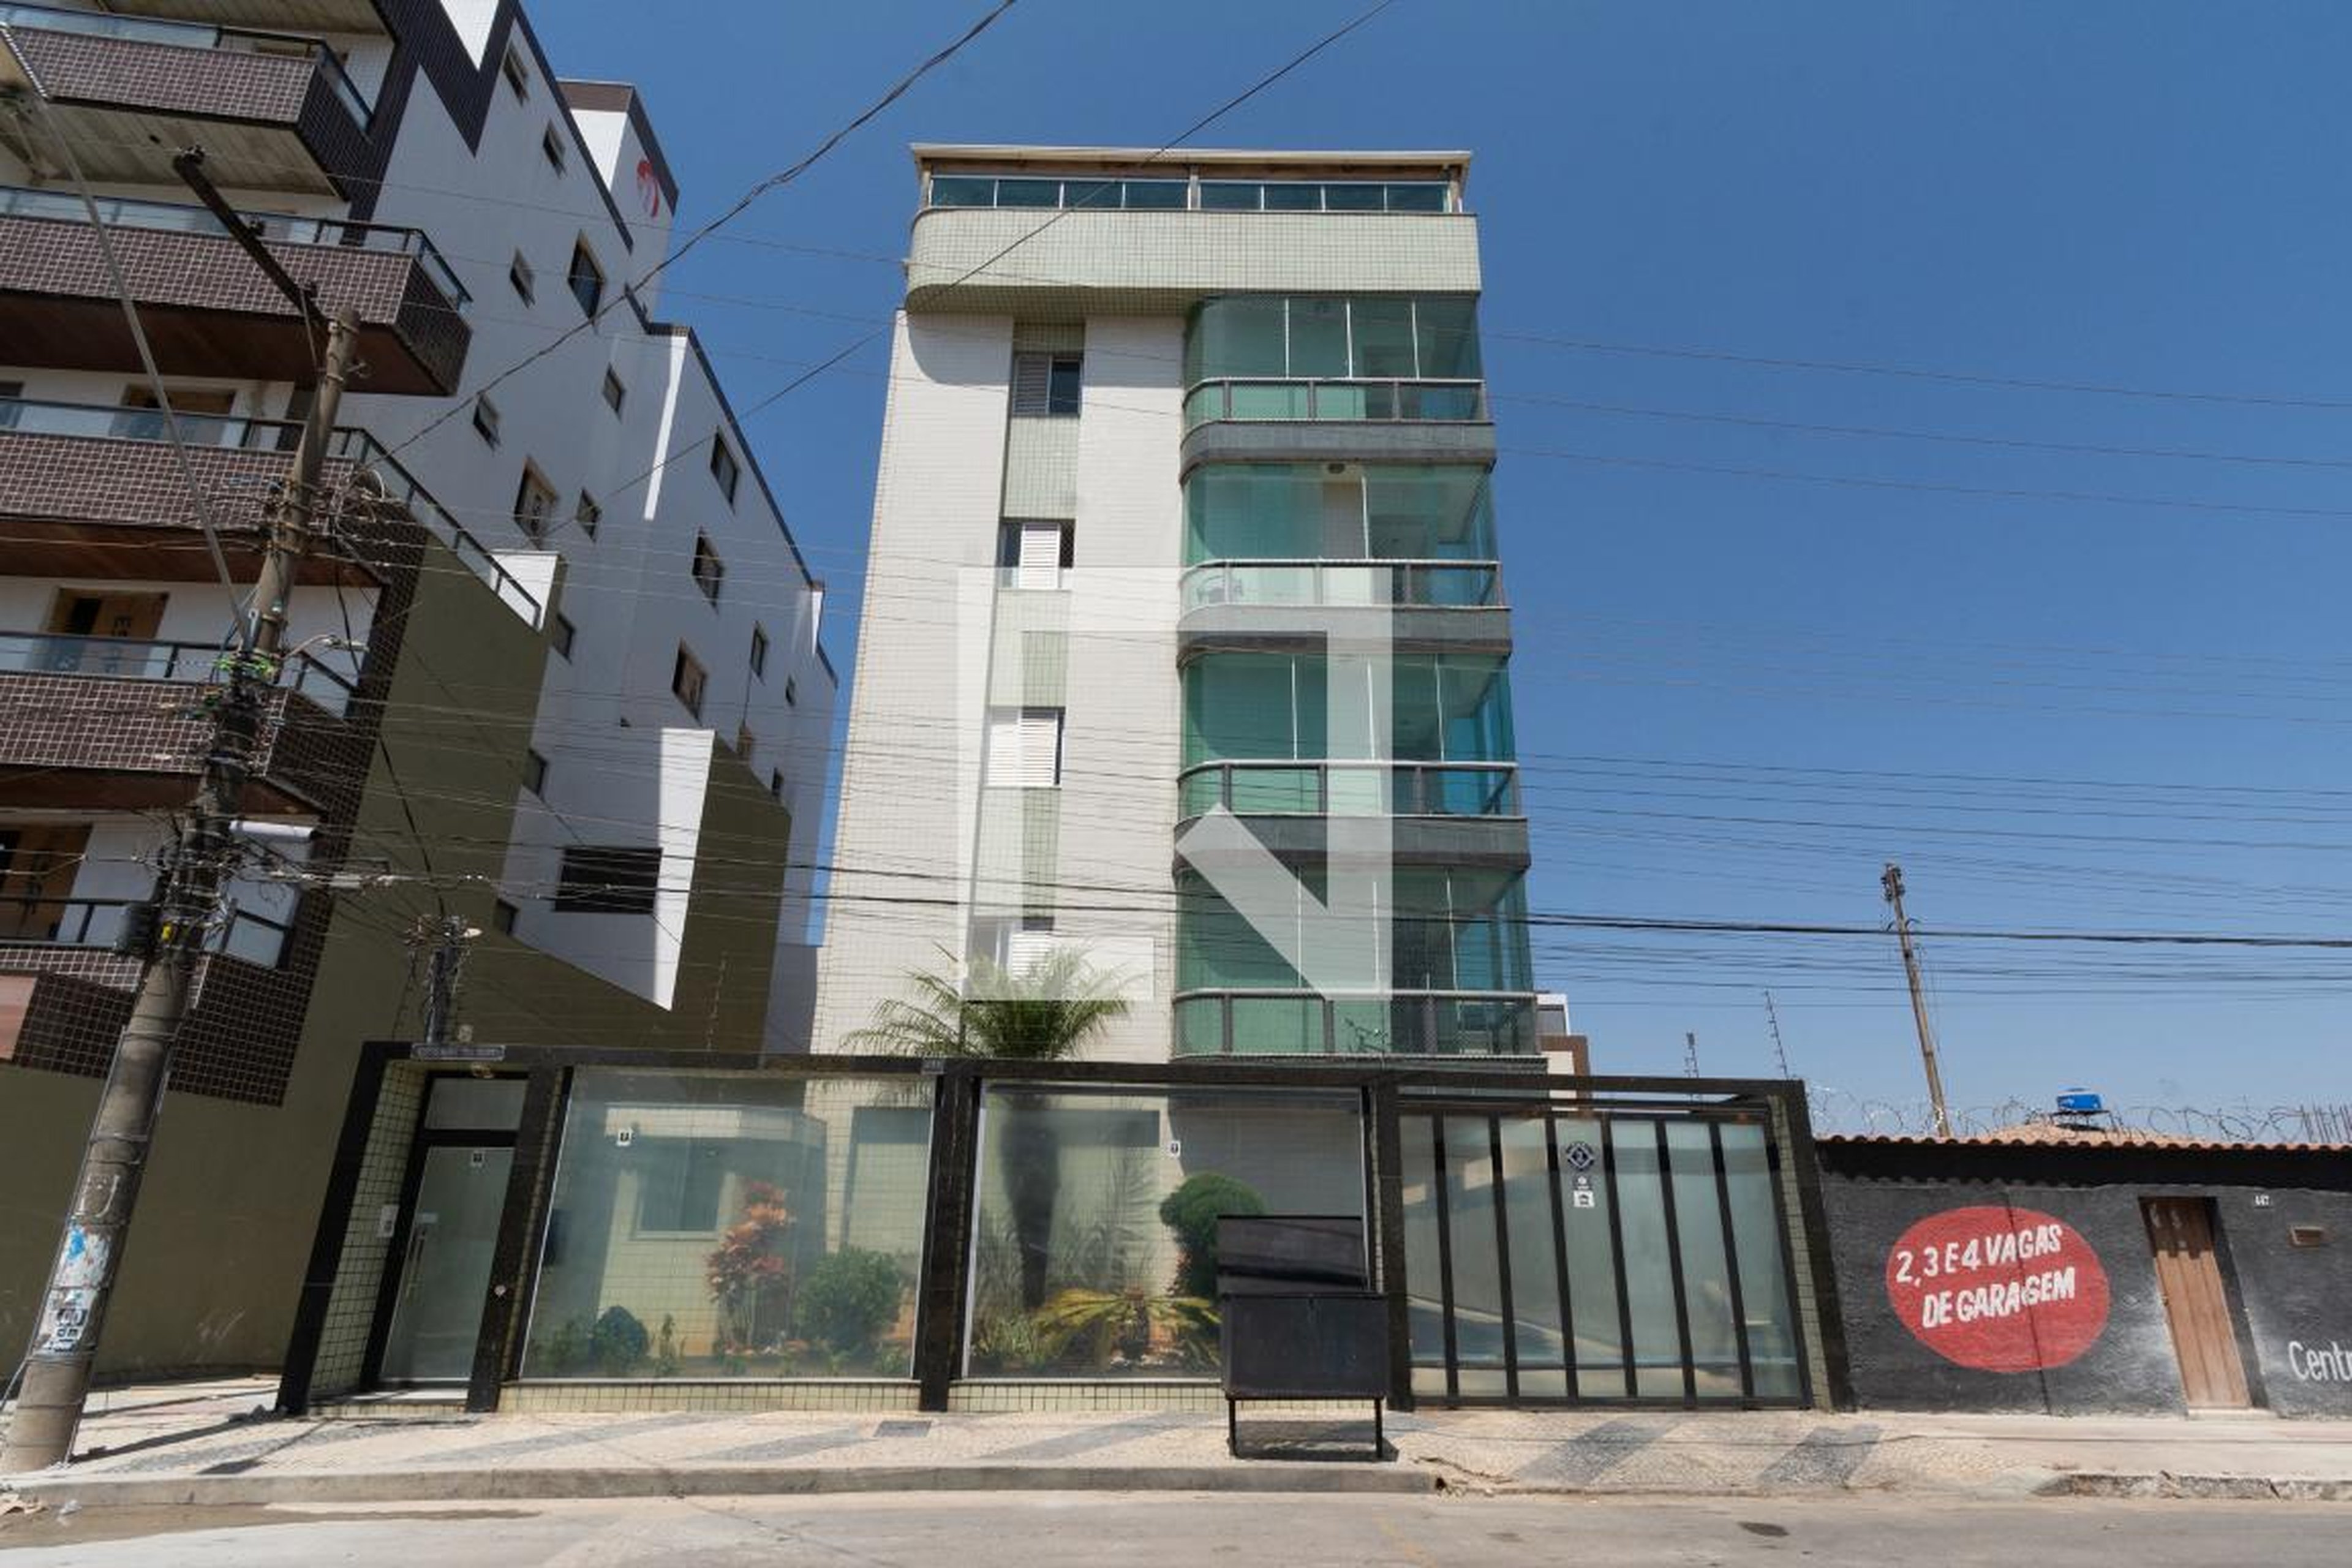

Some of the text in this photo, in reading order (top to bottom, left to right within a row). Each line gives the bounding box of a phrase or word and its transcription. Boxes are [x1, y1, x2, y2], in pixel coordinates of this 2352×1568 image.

[1945, 1242, 1959, 1273] E
[1962, 1238, 1981, 1270] 4
[1985, 1224, 2063, 1265] VAGAS
[1922, 1266, 2075, 1328] DE GARAGEM
